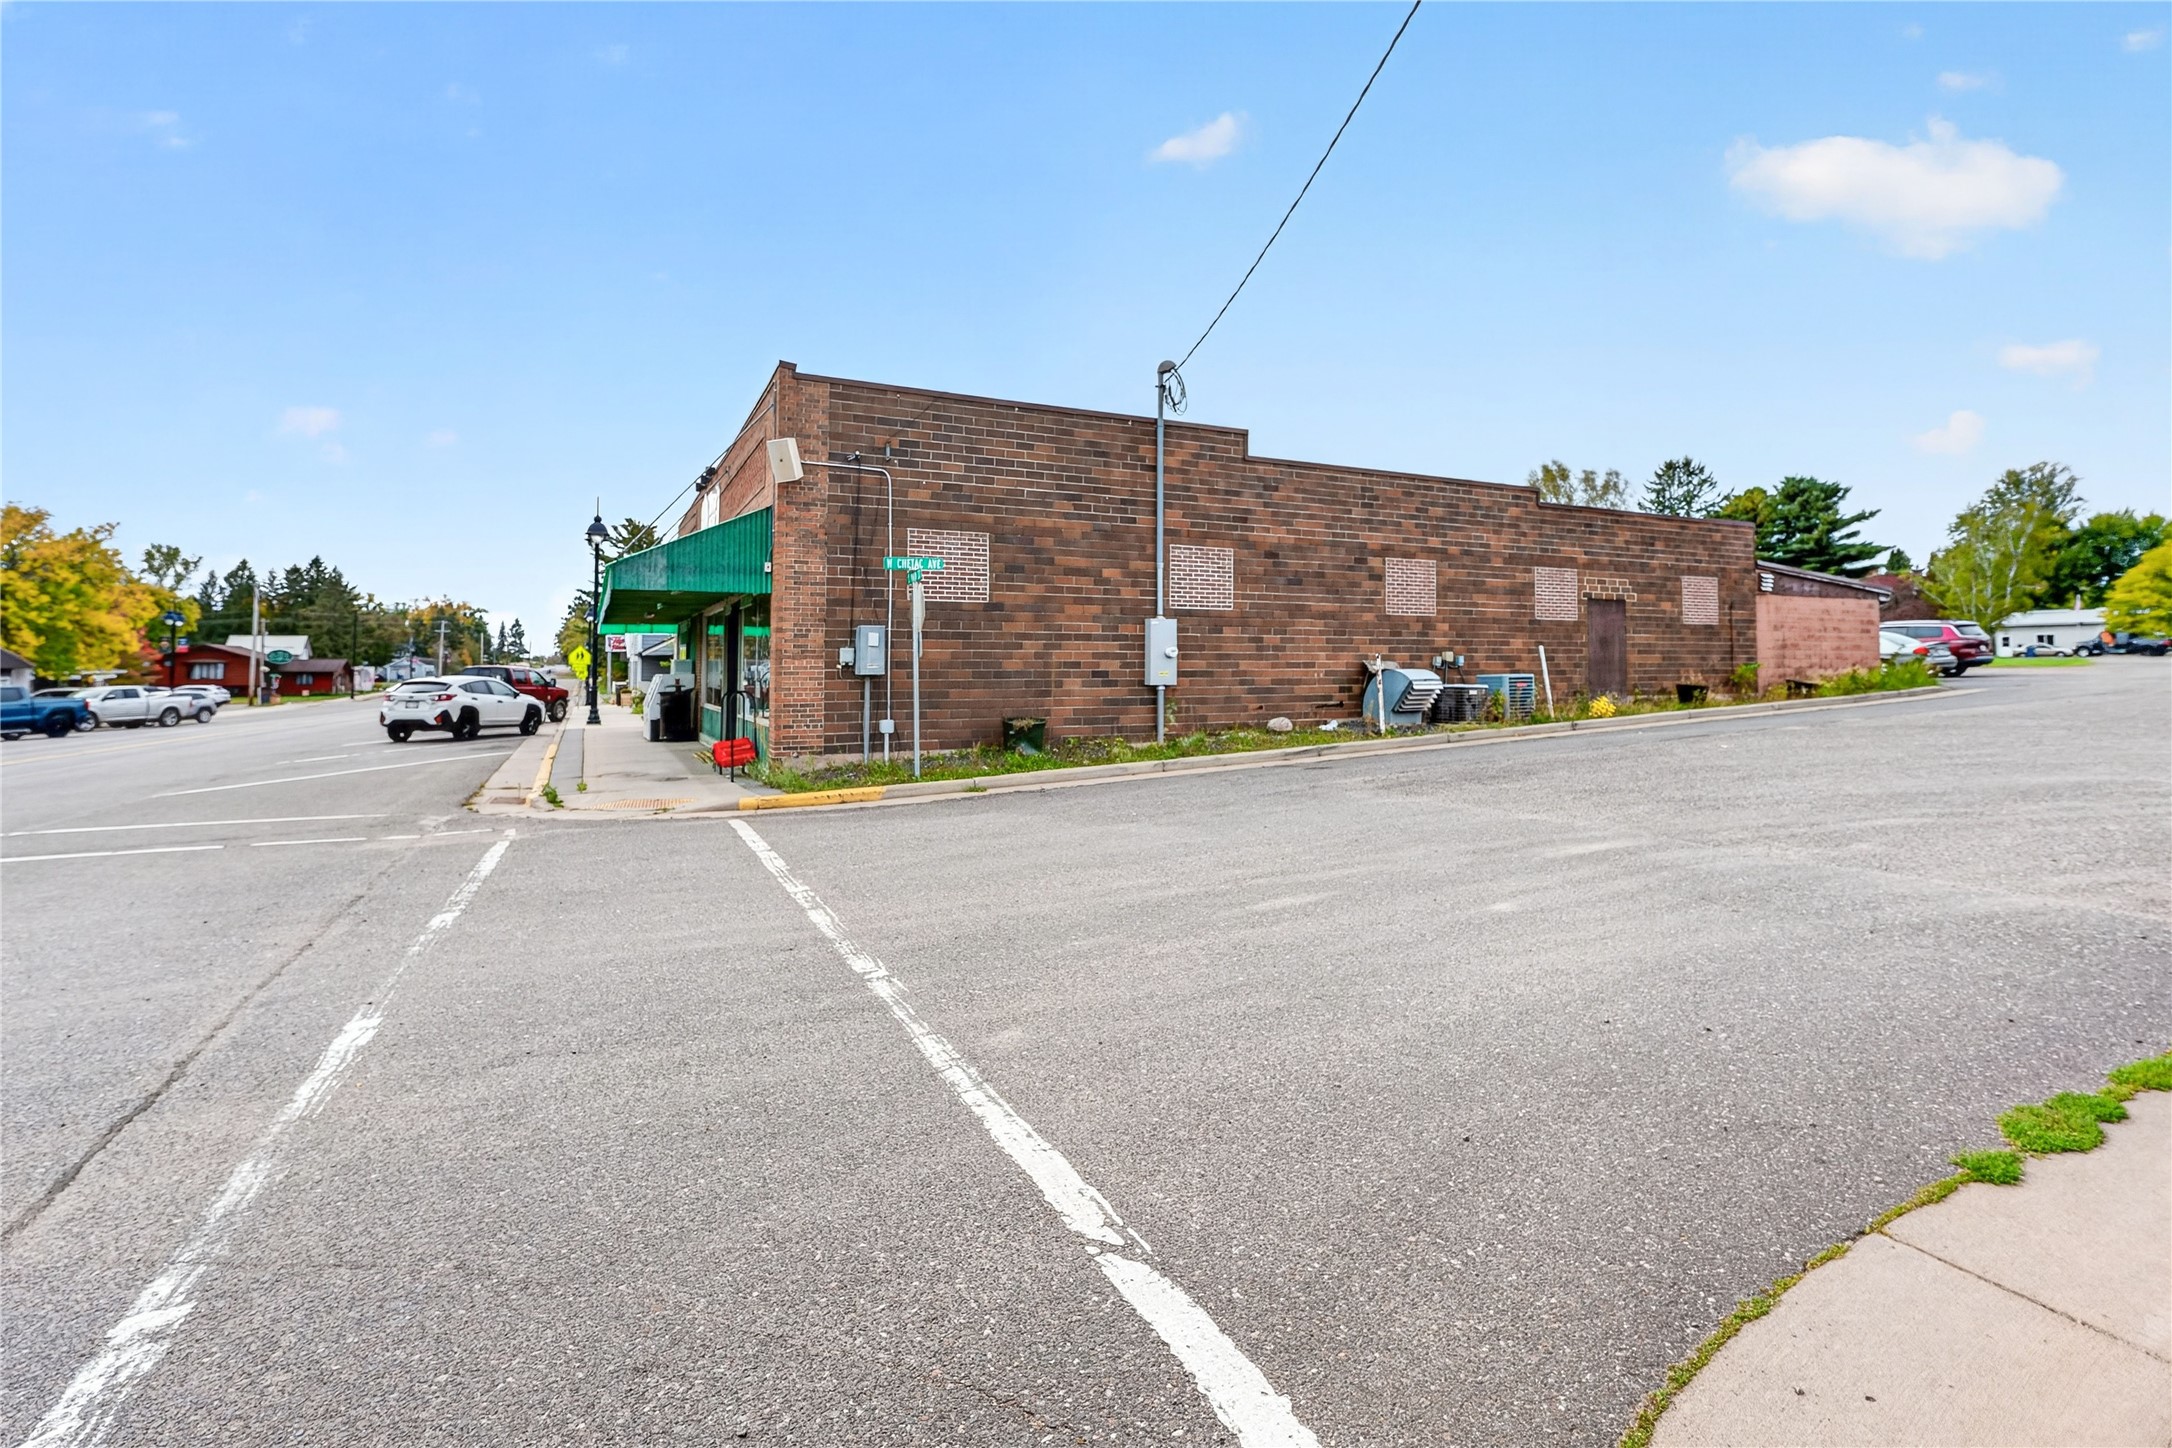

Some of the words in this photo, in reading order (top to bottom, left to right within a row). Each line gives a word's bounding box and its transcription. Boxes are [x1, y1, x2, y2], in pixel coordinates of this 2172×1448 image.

[886, 558, 893, 569] W
[897, 558, 924, 569] CHETAC
[927, 558, 941, 569] AVE
